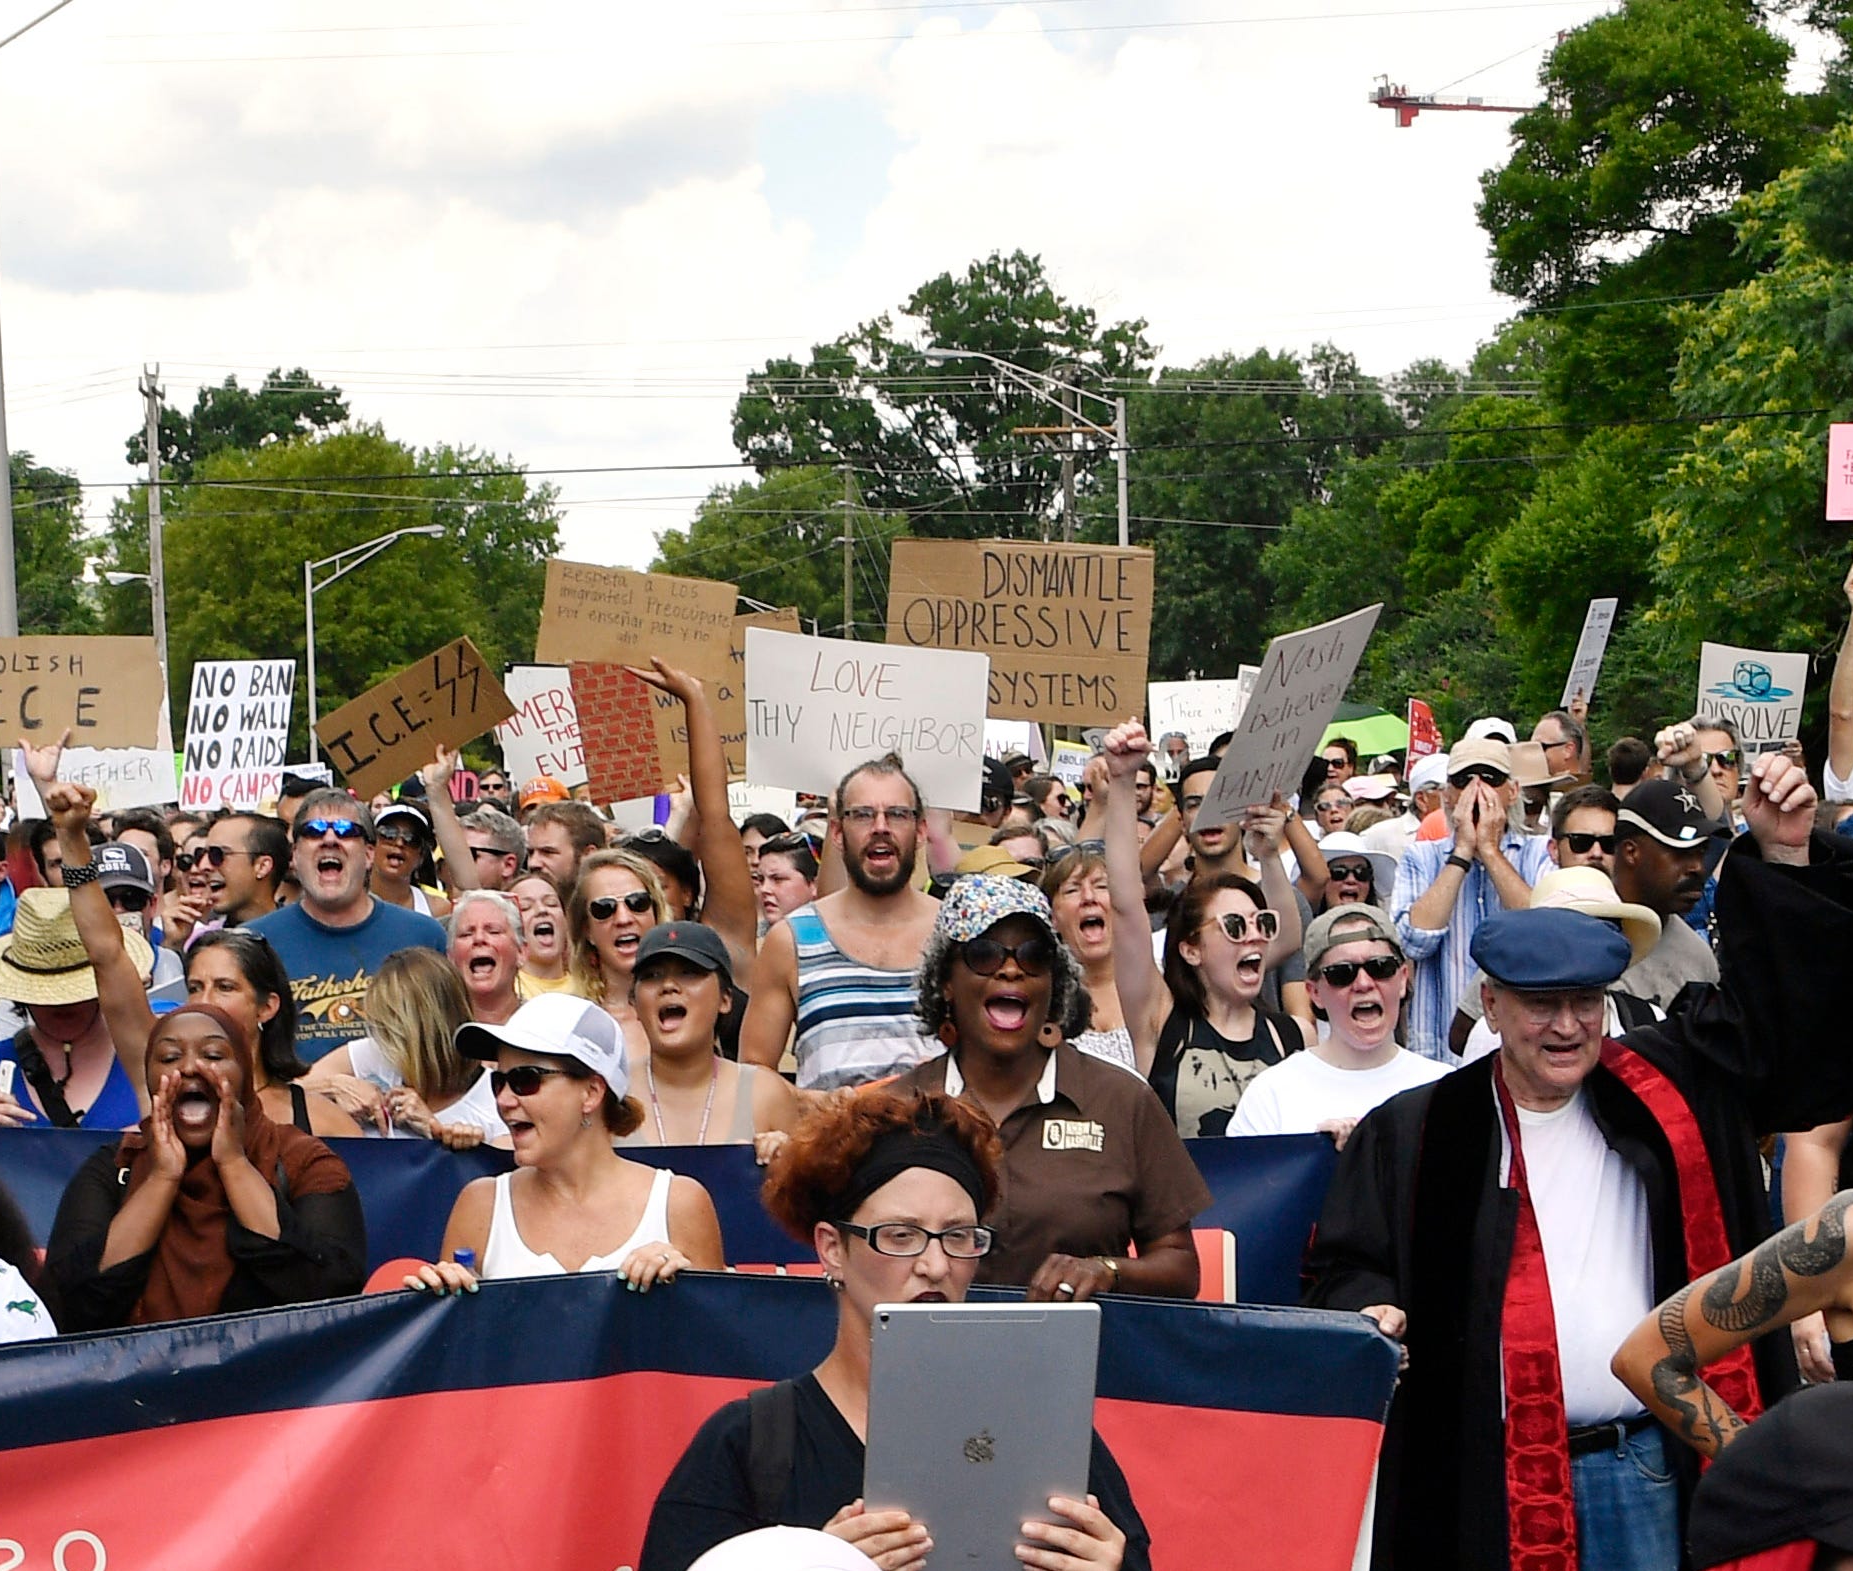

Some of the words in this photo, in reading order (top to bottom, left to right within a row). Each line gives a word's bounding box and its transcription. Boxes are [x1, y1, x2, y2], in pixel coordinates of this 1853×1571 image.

[984, 551, 1135, 601] DISMANTLE
[903, 597, 1134, 652] OPPRESSIVE
[810, 651, 902, 700] LOVE
[1264, 630, 1345, 694] Nash
[195, 665, 236, 698] NO
[248, 664, 293, 697] BAN
[190, 703, 229, 734] NO
[239, 701, 288, 732] WALL
[1163, 692, 1203, 721] There
[749, 699, 803, 744] THY
[830, 711, 977, 759] NEIGHBOR
[1273, 726, 1300, 751] in
[184, 739, 222, 772] NO
[231, 736, 287, 768] RAIDS
[536, 745, 586, 777] EVI
[182, 776, 213, 806] NO
[219, 771, 282, 804] CAMPS
[97, 862, 131, 873] COSTA
[294, 1032, 314, 1041] YOU
[314, 1030, 338, 1039] WILL
[339, 1029, 366, 1037] EVER
